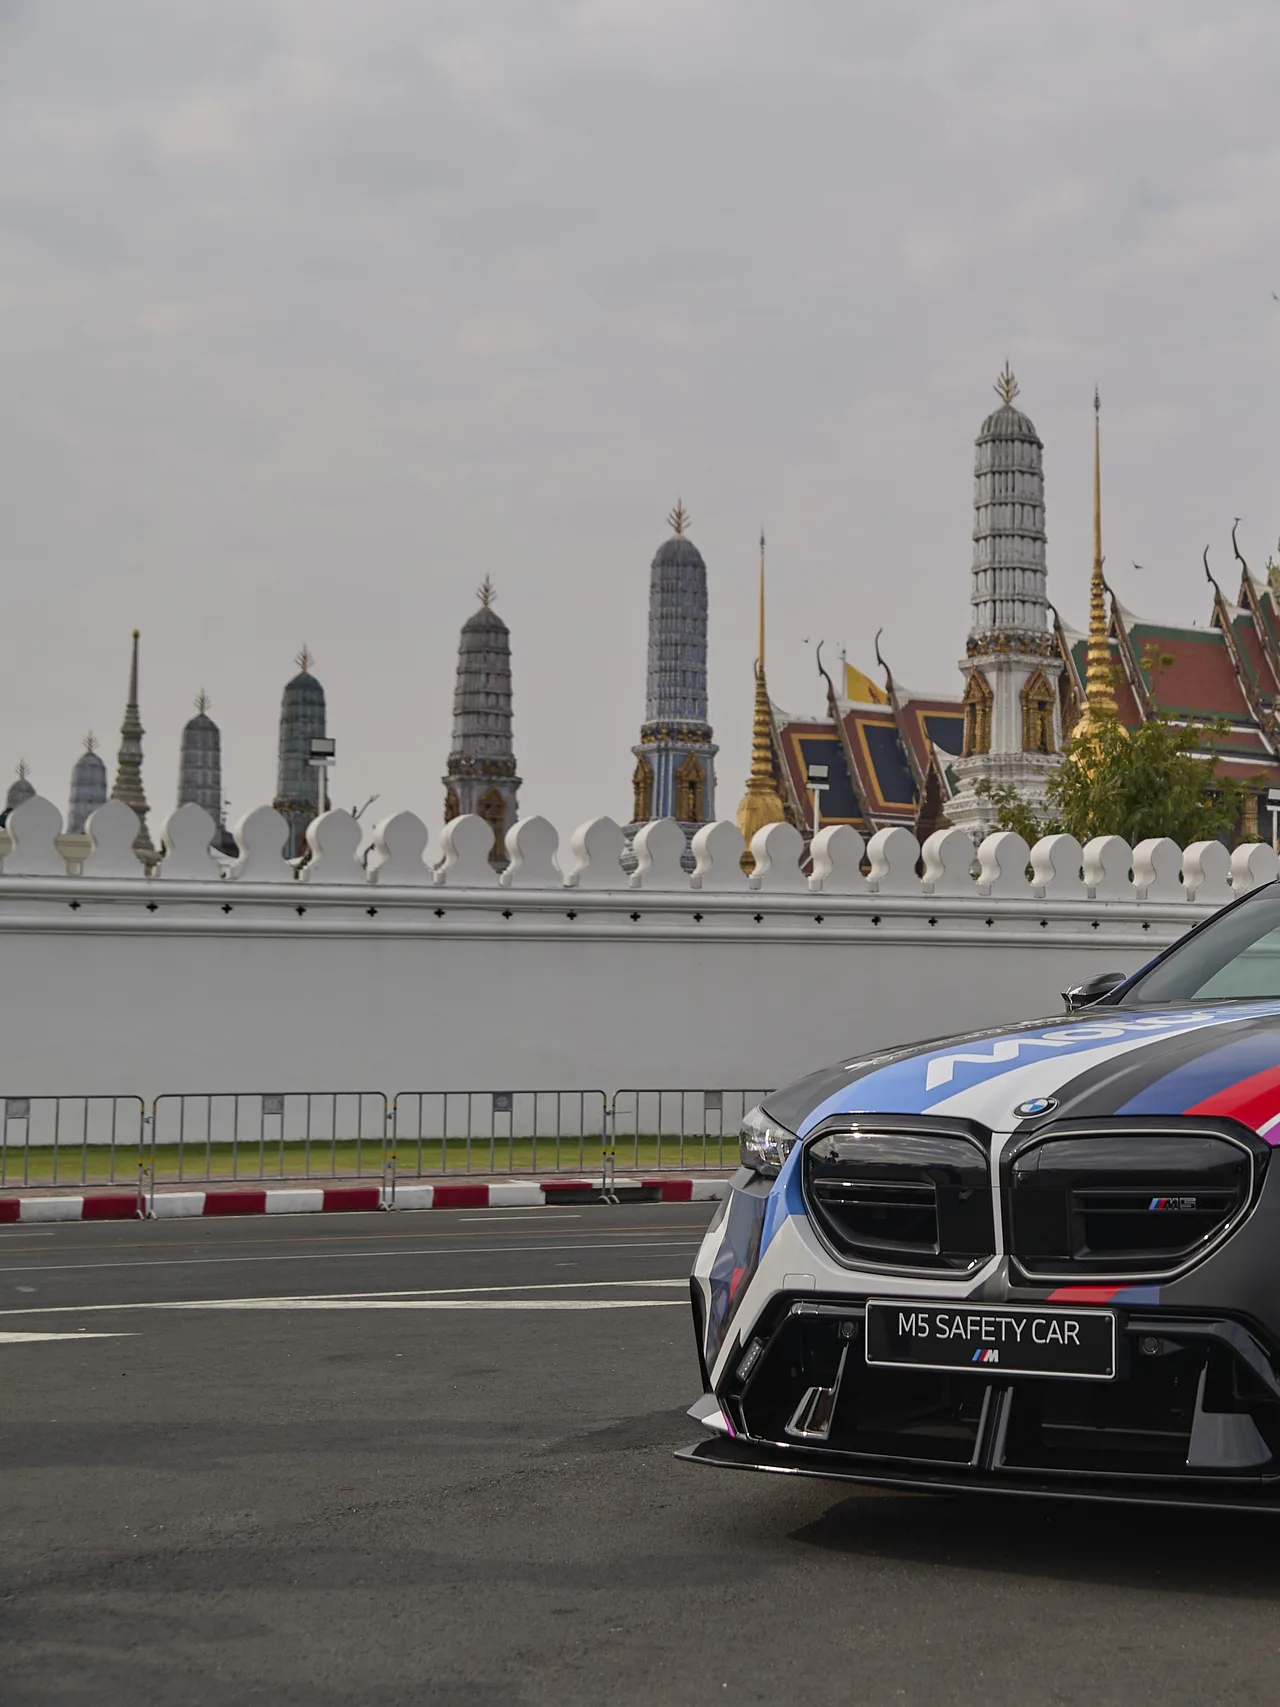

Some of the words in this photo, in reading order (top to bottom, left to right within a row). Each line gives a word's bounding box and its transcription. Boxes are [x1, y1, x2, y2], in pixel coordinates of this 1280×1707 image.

[1164, 1198, 1196, 1211] M5
[898, 1312, 930, 1337] M5
[936, 1314, 1027, 1342] SAFETY
[1032, 1319, 1081, 1346] CAR
[984, 1349, 999, 1363] M
